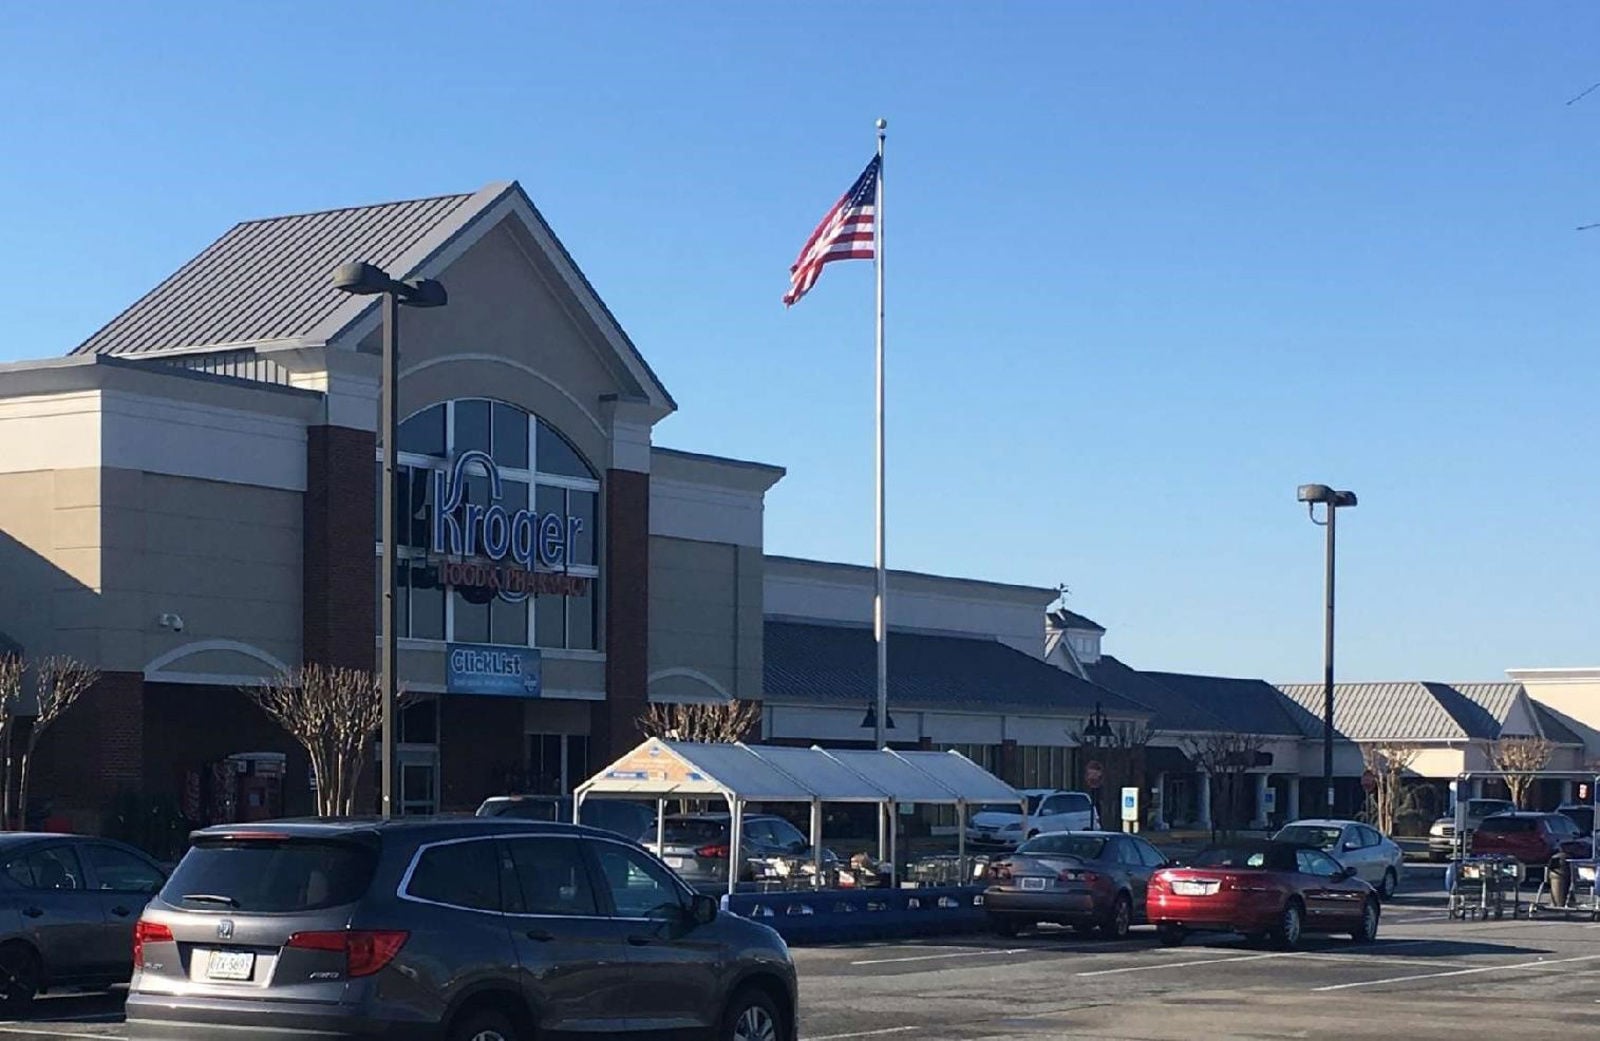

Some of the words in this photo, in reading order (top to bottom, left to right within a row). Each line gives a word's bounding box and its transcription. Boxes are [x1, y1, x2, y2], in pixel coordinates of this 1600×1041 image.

[434, 450, 583, 602] Kroger
[439, 561, 485, 586] FOOD
[451, 649, 521, 677] ClickList
